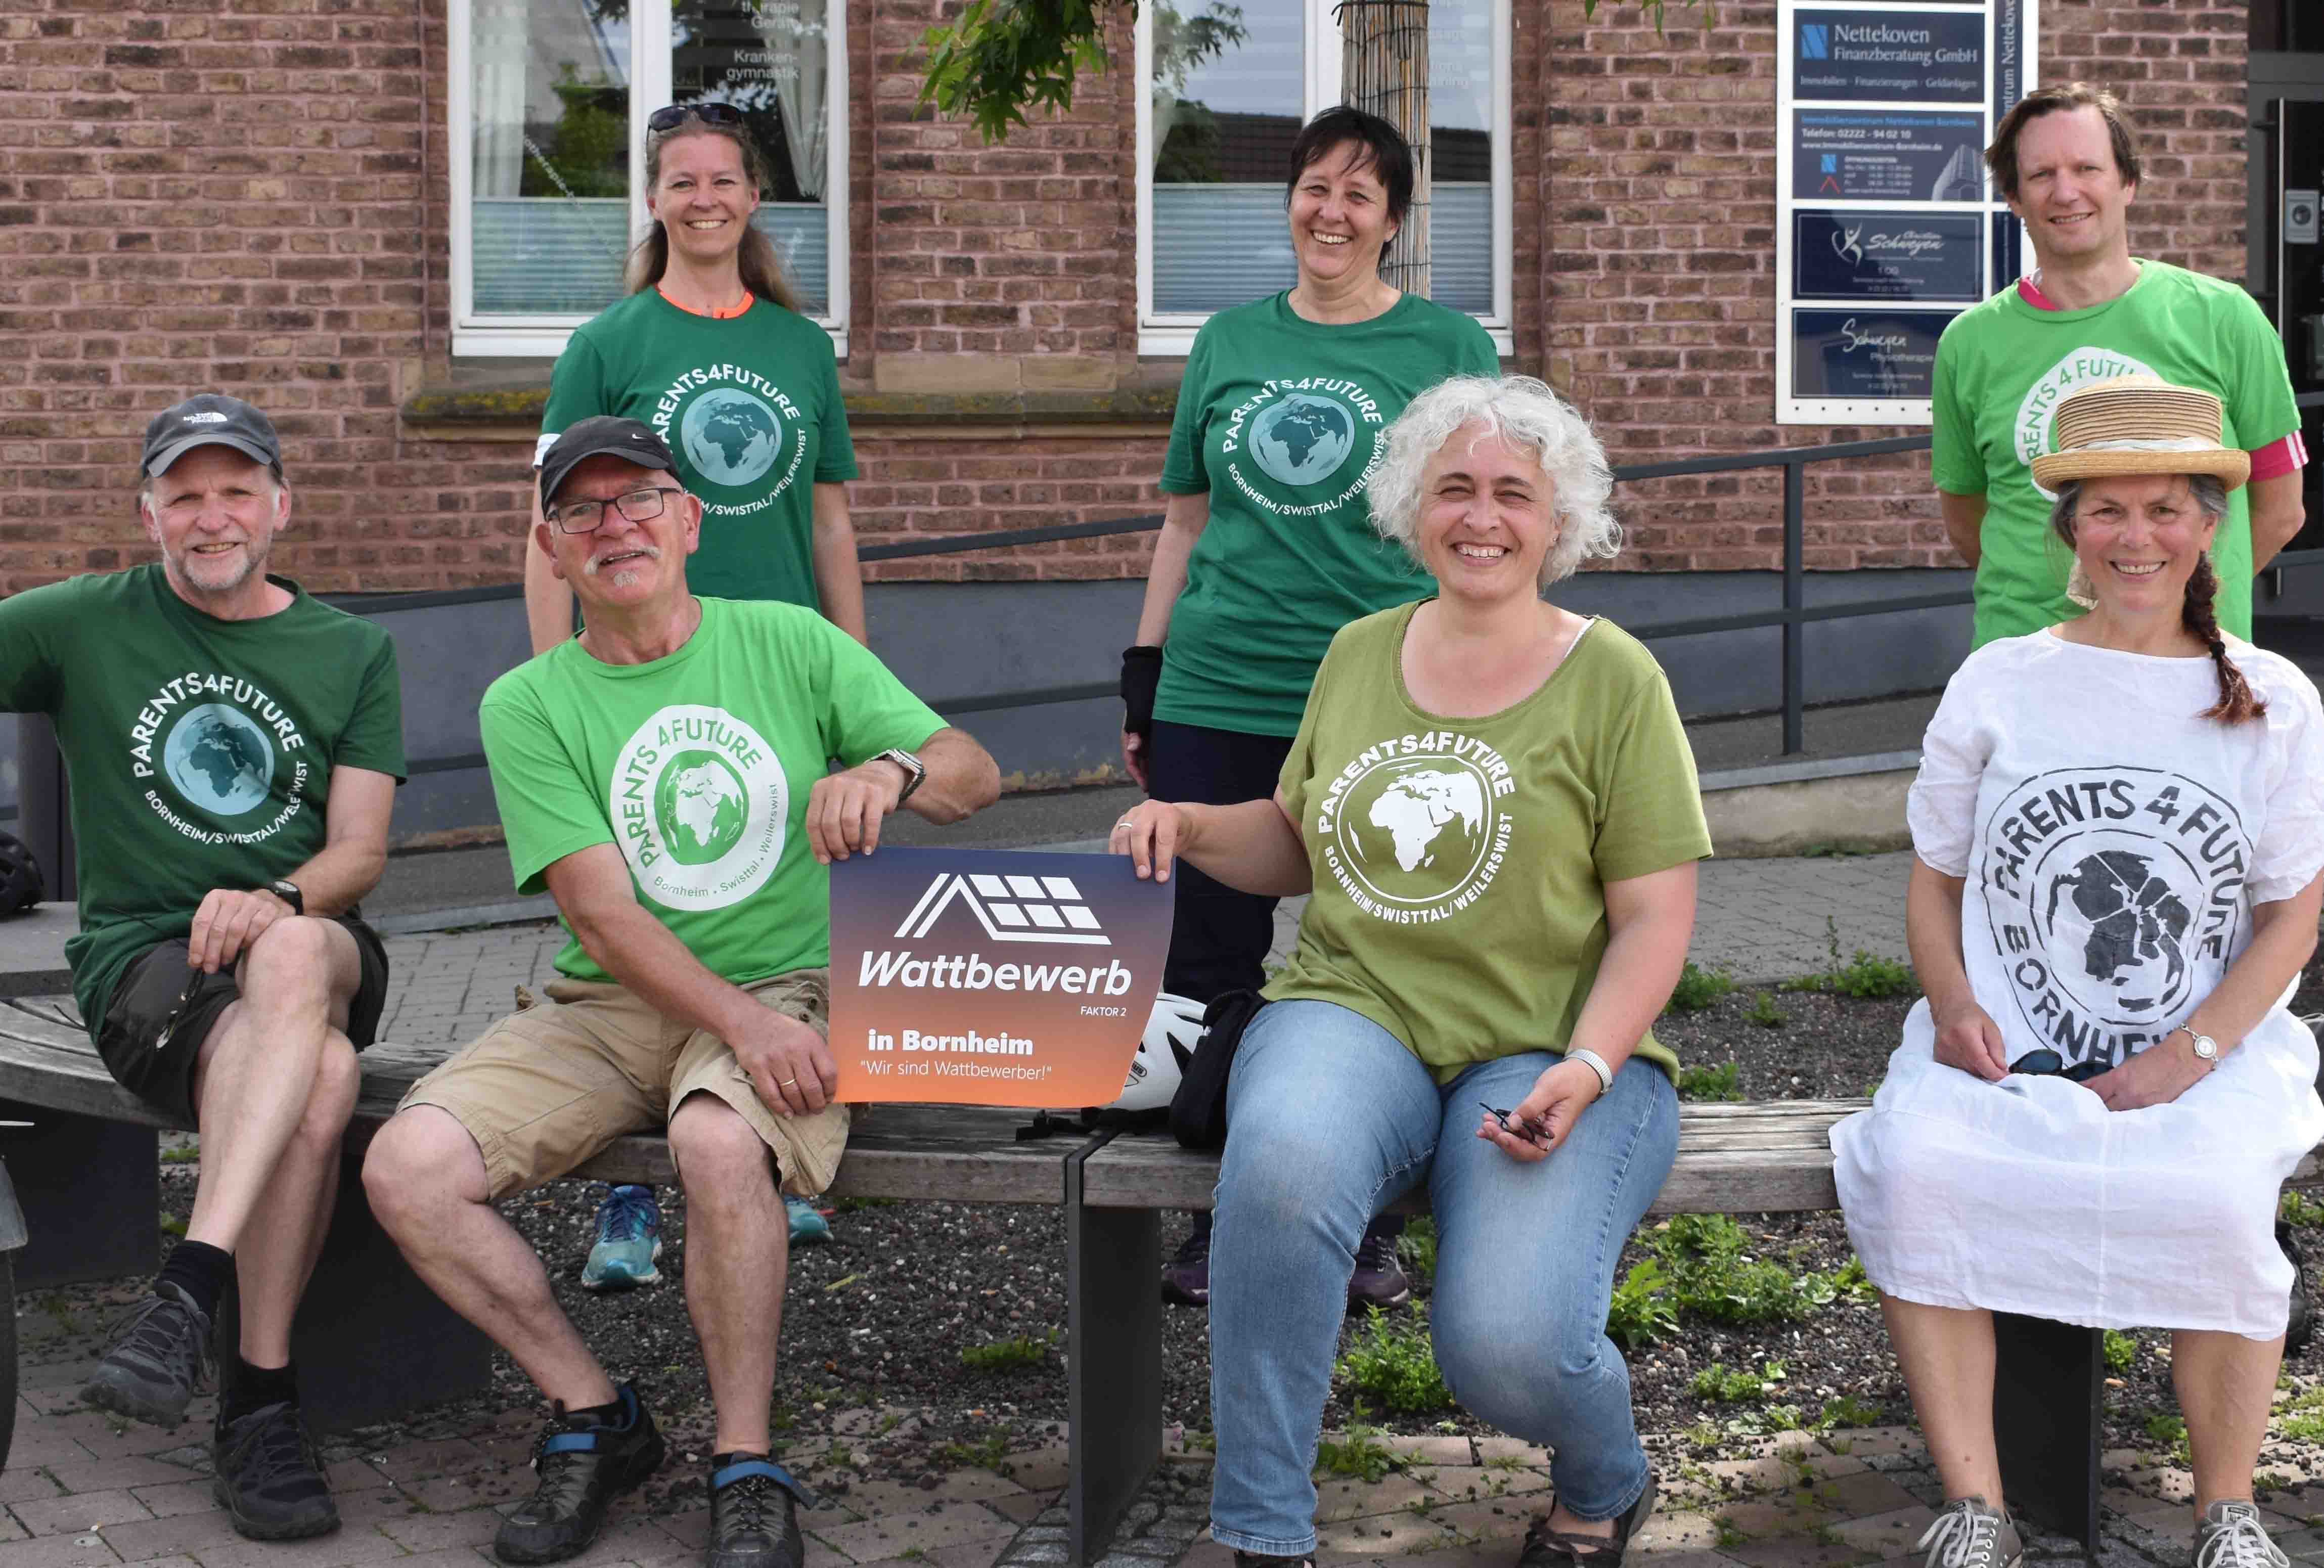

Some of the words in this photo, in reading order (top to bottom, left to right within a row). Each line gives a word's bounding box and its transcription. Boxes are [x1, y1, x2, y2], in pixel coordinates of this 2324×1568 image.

[734, 49, 797, 64] Kranken-
[1834, 23, 1930, 43] Nettekoven
[1834, 47, 1933, 66] Finanzberatung
[1935, 48, 1978, 63] GmbH
[726, 66, 799, 81] gymnastik
[1802, 128, 1837, 138] Telefon:
[652, 364, 801, 450] ARENTS4FUTURE
[1223, 378, 1383, 453] PARENTS4FUTURE
[2023, 382, 2057, 461] RENTS
[2075, 358, 2134, 379] FUT
[130, 672, 305, 778] PARENTS4FUTURE
[622, 744, 660, 869] PARENTS
[1318, 731, 1516, 833] PARENTS4FUTURE
[654, 875, 708, 898] Bornheim
[720, 861, 761, 892] Swisttal
[758, 783, 778, 855] Weilerswist
[1994, 779, 2135, 900] PARENTS
[2143, 786, 2180, 825] 4
[859, 951, 1132, 996] Wattbewerb
[2003, 924, 2173, 1065] BORNHE
[868, 1028, 893, 1051] in
[902, 1029, 1033, 1055] Bornheim
[1081, 1006, 1119, 1016] FAKTOR
[1120, 1007, 1127, 1017] 2
[861, 1060, 893, 1076] "Wir
[898, 1059, 929, 1076] sind
[934, 1060, 1052, 1080] Wattbewerber!"
